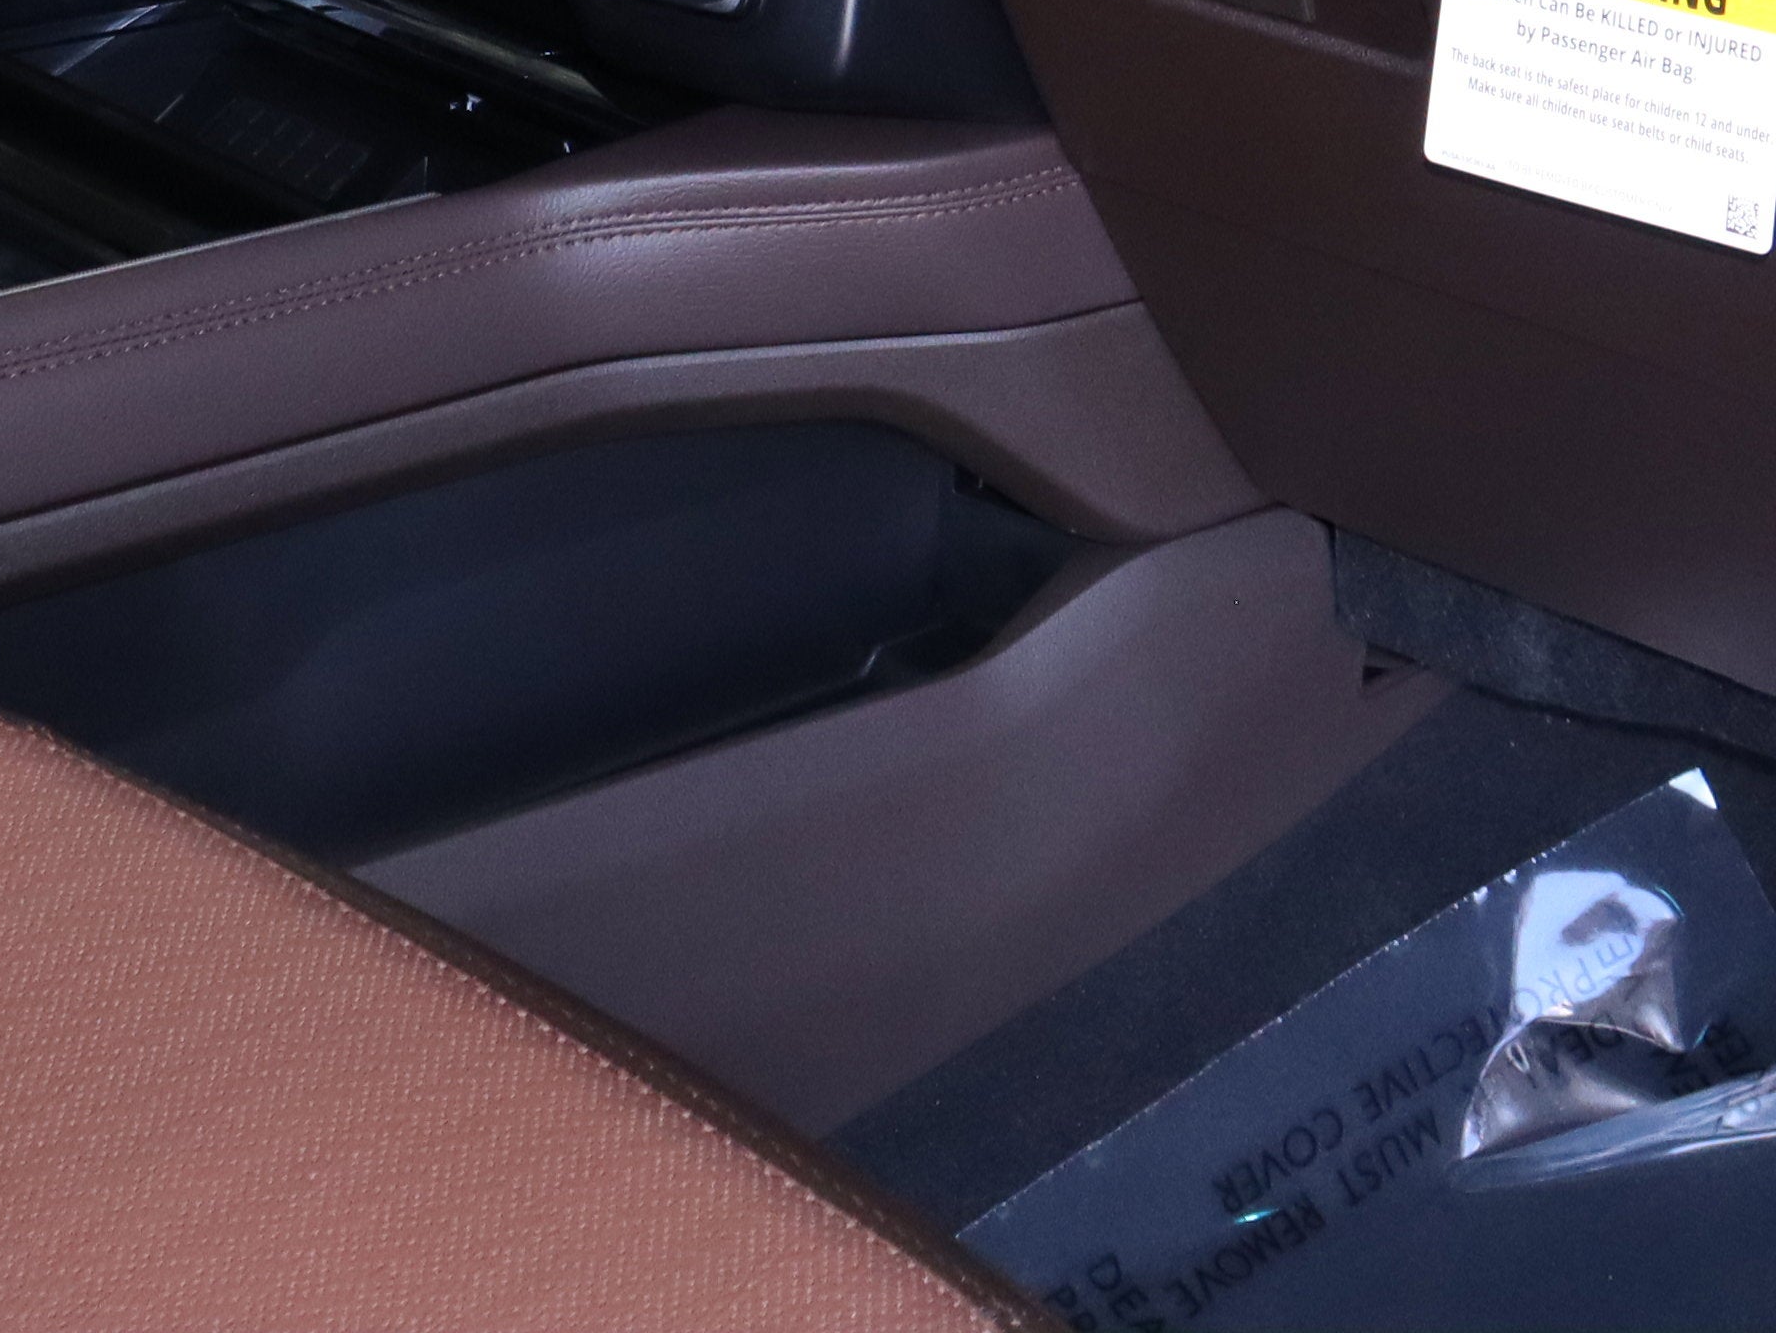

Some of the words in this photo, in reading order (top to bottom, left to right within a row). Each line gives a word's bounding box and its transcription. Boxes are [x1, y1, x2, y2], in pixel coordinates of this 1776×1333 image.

[1517, 19, 1536, 44] by
[1541, 26, 1626, 63] Passenger
[1630, 49, 1656, 69] Air
[1662, 57, 1696, 85] Bag.
[1575, 0, 1595, 22] Be
[1601, 8, 1658, 37] KILLED
[1665, 28, 1683, 43] or
[1688, 29, 1762, 62] INJURED
[1452, 47, 1470, 64] The
[1471, 53, 1496, 77] back
[1499, 64, 1520, 78] seat
[1525, 68, 1532, 81] is
[1537, 71, 1553, 87] the
[1558, 78, 1589, 96] safest
[1592, 87, 1620, 105] place
[1625, 93, 1641, 109] for
[1644, 99, 1689, 122] children
[1696, 112, 1707, 128] 12
[1711, 119, 1732, 133] and
[1737, 125, 1773, 144] under.
[1468, 76, 1496, 98] Make
[1500, 88, 1522, 103] sure
[1526, 93, 1538, 108] all
[1542, 97, 1587, 120] children
[1589, 109, 1608, 126] use
[1612, 118, 1634, 134] seat
[1638, 122, 1665, 141] belts
[1670, 134, 1681, 144] or
[1685, 135, 1712, 153] child
[1716, 146, 1748, 163] seats.
[1213, 1106, 1344, 1215] COVER
[1341, 1111, 1441, 1207] MUST
[1169, 1192, 1325, 1319] REMOVE
